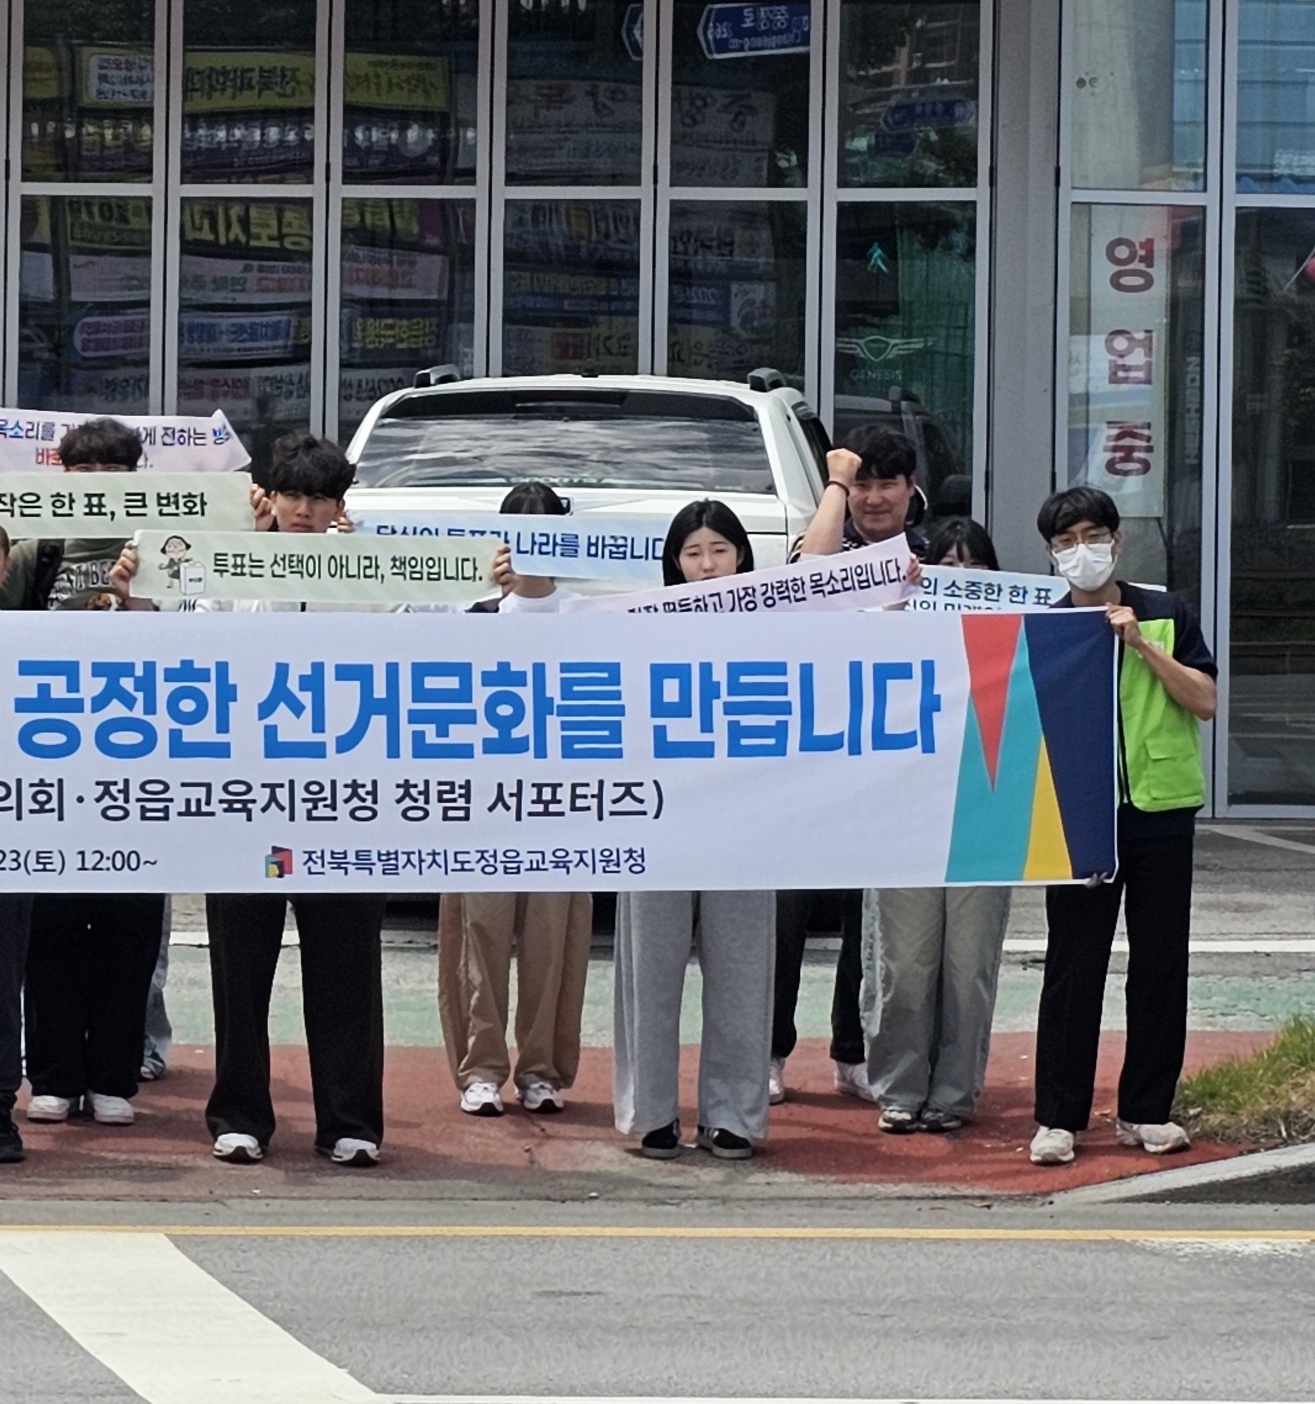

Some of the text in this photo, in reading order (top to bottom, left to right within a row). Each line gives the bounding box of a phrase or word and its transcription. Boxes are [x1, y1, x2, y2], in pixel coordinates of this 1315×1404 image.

[161, 426, 208, 447] 전하는
[50, 492, 76, 517] 한
[83, 493, 116, 521] 표,
[124, 492, 148, 517] 큰
[156, 491, 207, 518] 변화
[516, 531, 580, 559] 나라를
[212, 552, 484, 584] 투표는 선택이 아니라, 책임입니다.
[726, 585, 757, 613] 가장
[759, 575, 807, 609] 강력한
[809, 558, 907, 600] 목소리입니다.
[943, 579, 1003, 603] 소중한
[1008, 584, 1028, 605] 한
[1032, 587, 1053, 607] 표
[14, 659, 237, 759] 공정한
[257, 660, 625, 759] 선거문화를
[649, 659, 941, 759] 만듭니다
[394, 778, 472, 822] 청렴
[487, 778, 665, 821] 서포터즈)
[75, 849, 158, 872] 12:00~
[302, 847, 646, 877] 전북특별자치도정읍교육지원청
